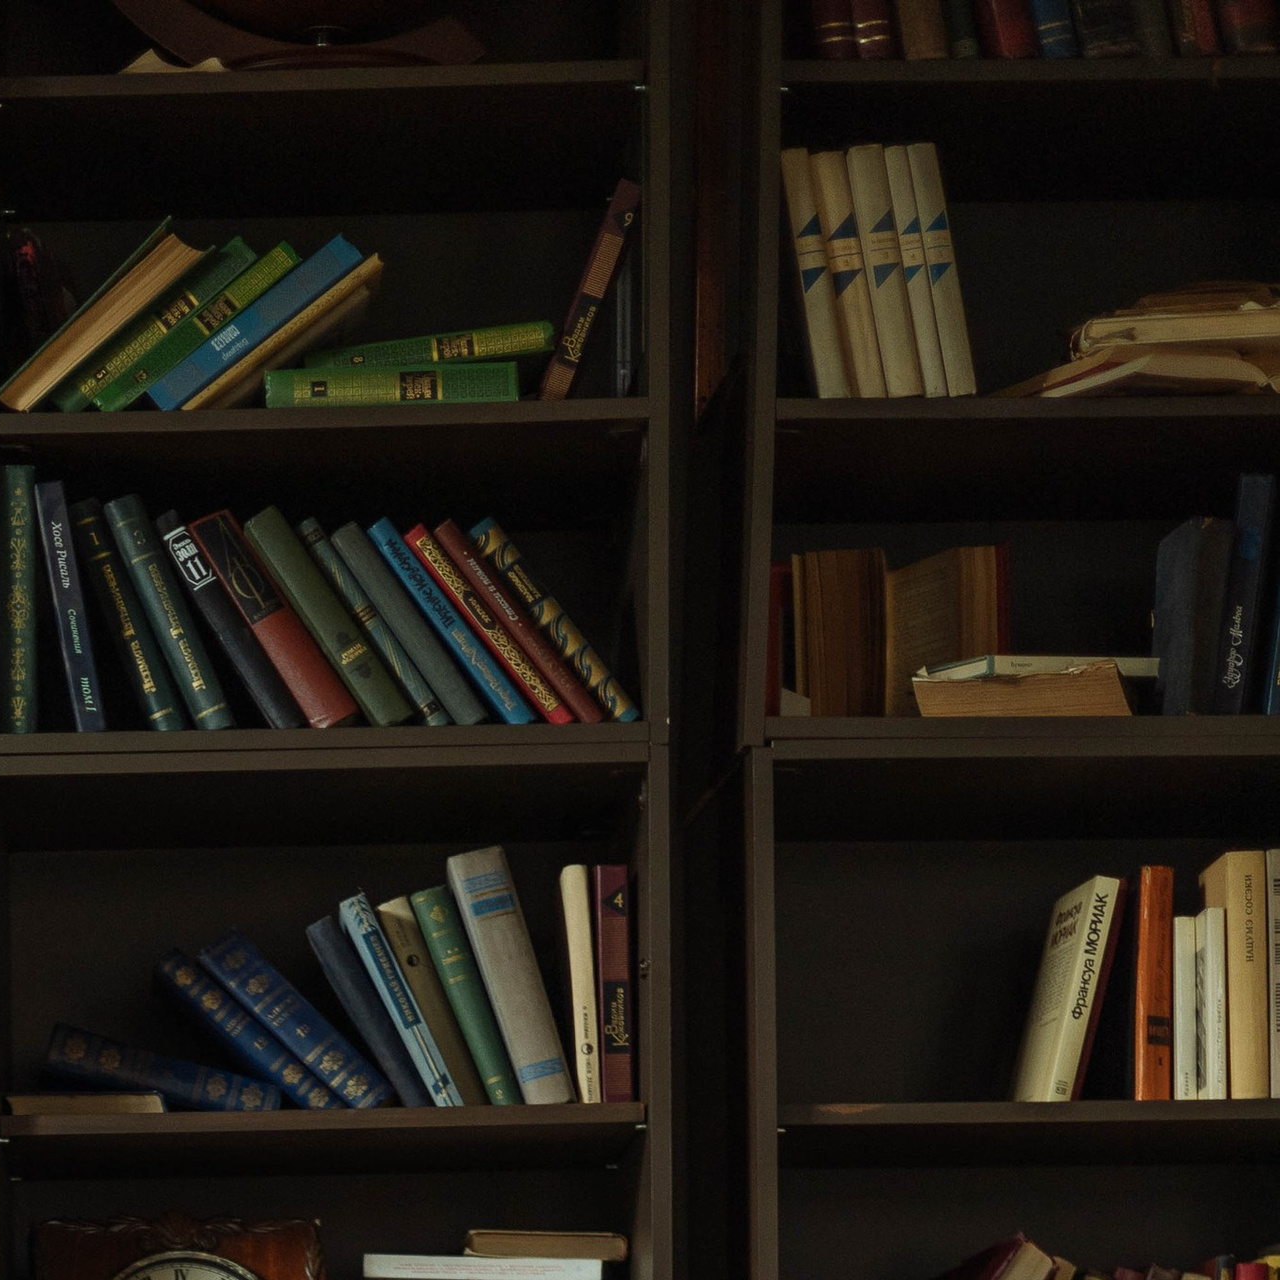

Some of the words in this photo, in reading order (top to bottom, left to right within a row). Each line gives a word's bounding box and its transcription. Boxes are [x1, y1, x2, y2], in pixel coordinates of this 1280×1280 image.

[561, 315, 587, 351] Вадим
[562, 304, 599, 365] Кожевников
[49, 519, 66, 548] Хосе
[90, 530, 100, 547] 1
[53, 548, 74, 590] Рисаль
[185, 555, 208, 581] 11
[465, 555, 492, 587] поэмы
[486, 583, 497, 594] и
[100, 562, 137, 640] Татьяничева
[147, 562, 185, 639] Татьяничева
[492, 590, 520, 623] Стихи
[64, 607, 85, 655] Сочинения
[128, 639, 157, 694] Людмила
[176, 637, 206, 692] Людмила
[1221, 646, 1242, 690] Эдуардо
[78, 674, 94, 705] том
[613, 892, 624, 907] 4
[1243, 873, 1253, 915] СОСЭКИ
[367, 932, 396, 980] ГРИБАЧЕВ
[1069, 957, 1095, 1021] Франсуа
[1083, 891, 1109, 956] МОРИАК
[1244, 918, 1255, 962] НАЦУМЭ
[388, 978, 416, 1023] НИКОЛАЙ
[604, 1001, 619, 1034] Вадим
[612, 986, 629, 1046] Кожевников
